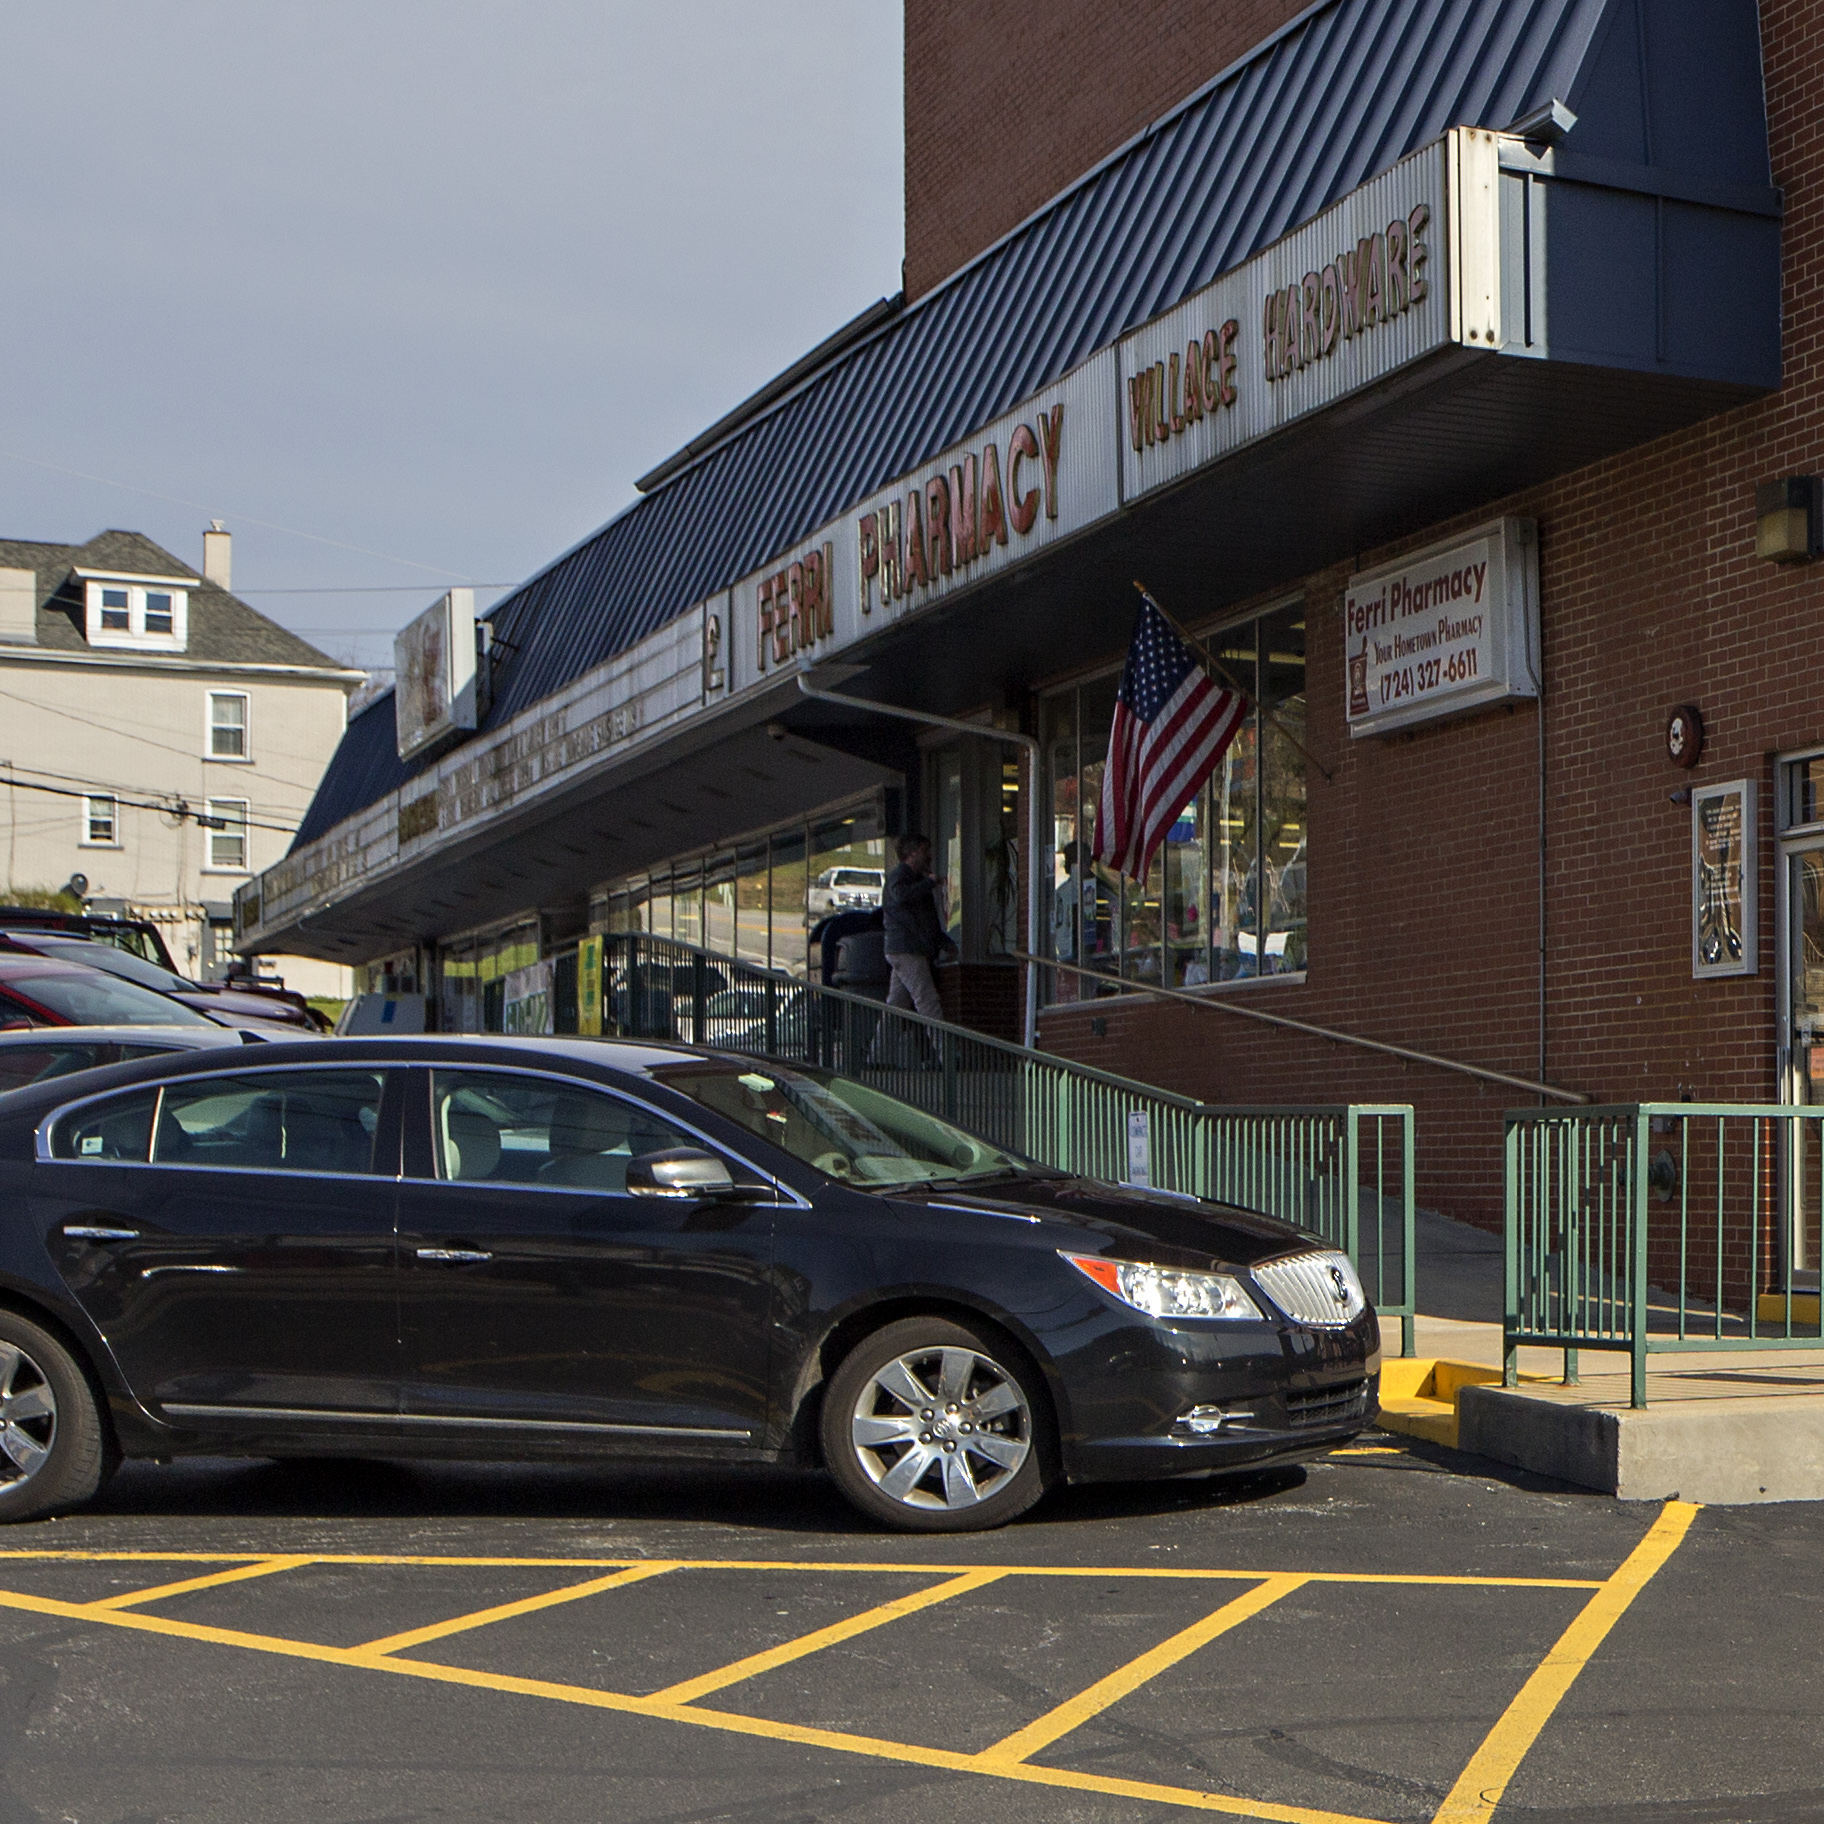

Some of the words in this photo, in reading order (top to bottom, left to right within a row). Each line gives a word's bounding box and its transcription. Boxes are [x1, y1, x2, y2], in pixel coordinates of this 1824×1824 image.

[1128, 319, 1239, 451] VILLAGE
[1264, 203, 1429, 381] HARDWARE
[757, 542, 832, 670] FERRI
[858, 403, 1064, 614] PHARMACY
[1348, 586, 1387, 637] Ferri
[1390, 561, 1487, 622] Pharmacy
[1381, 667, 1414, 704] (724)
[1418, 648, 1477, 691] 327-6611
